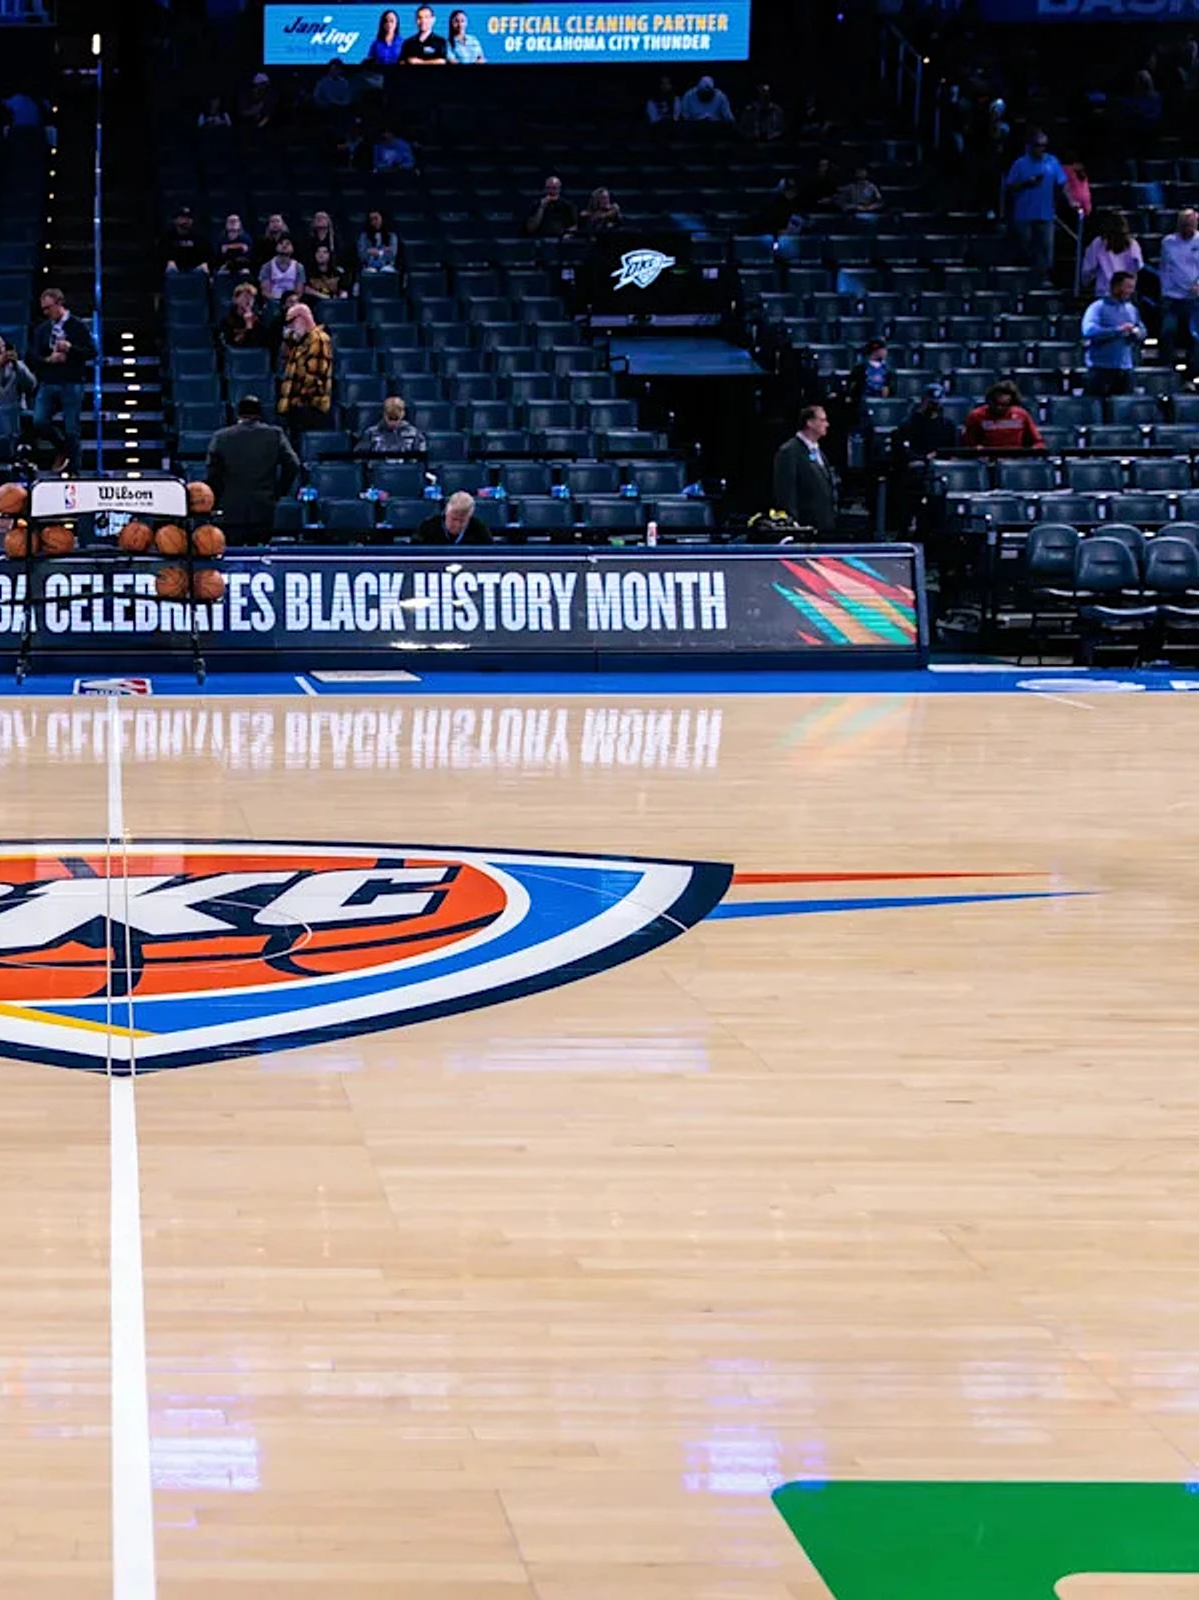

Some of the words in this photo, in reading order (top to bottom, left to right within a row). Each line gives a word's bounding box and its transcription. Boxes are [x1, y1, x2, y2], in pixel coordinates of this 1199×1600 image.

[284, 16, 333, 33] Jani
[487, 16, 561, 34] OFFICIAL
[565, 16, 649, 33] CLEANING
[653, 14, 729, 32] PARTNER
[504, 36, 523, 52] OF
[525, 35, 605, 51] OKLAHOMA
[608, 35, 640, 50] CITY
[643, 34, 711, 49] THUNDER
[98, 486, 153, 500] Wilson
[285, 572, 403, 631] BLACK
[413, 572, 577, 631] HISTORY
[587, 572, 727, 631] MONTH
